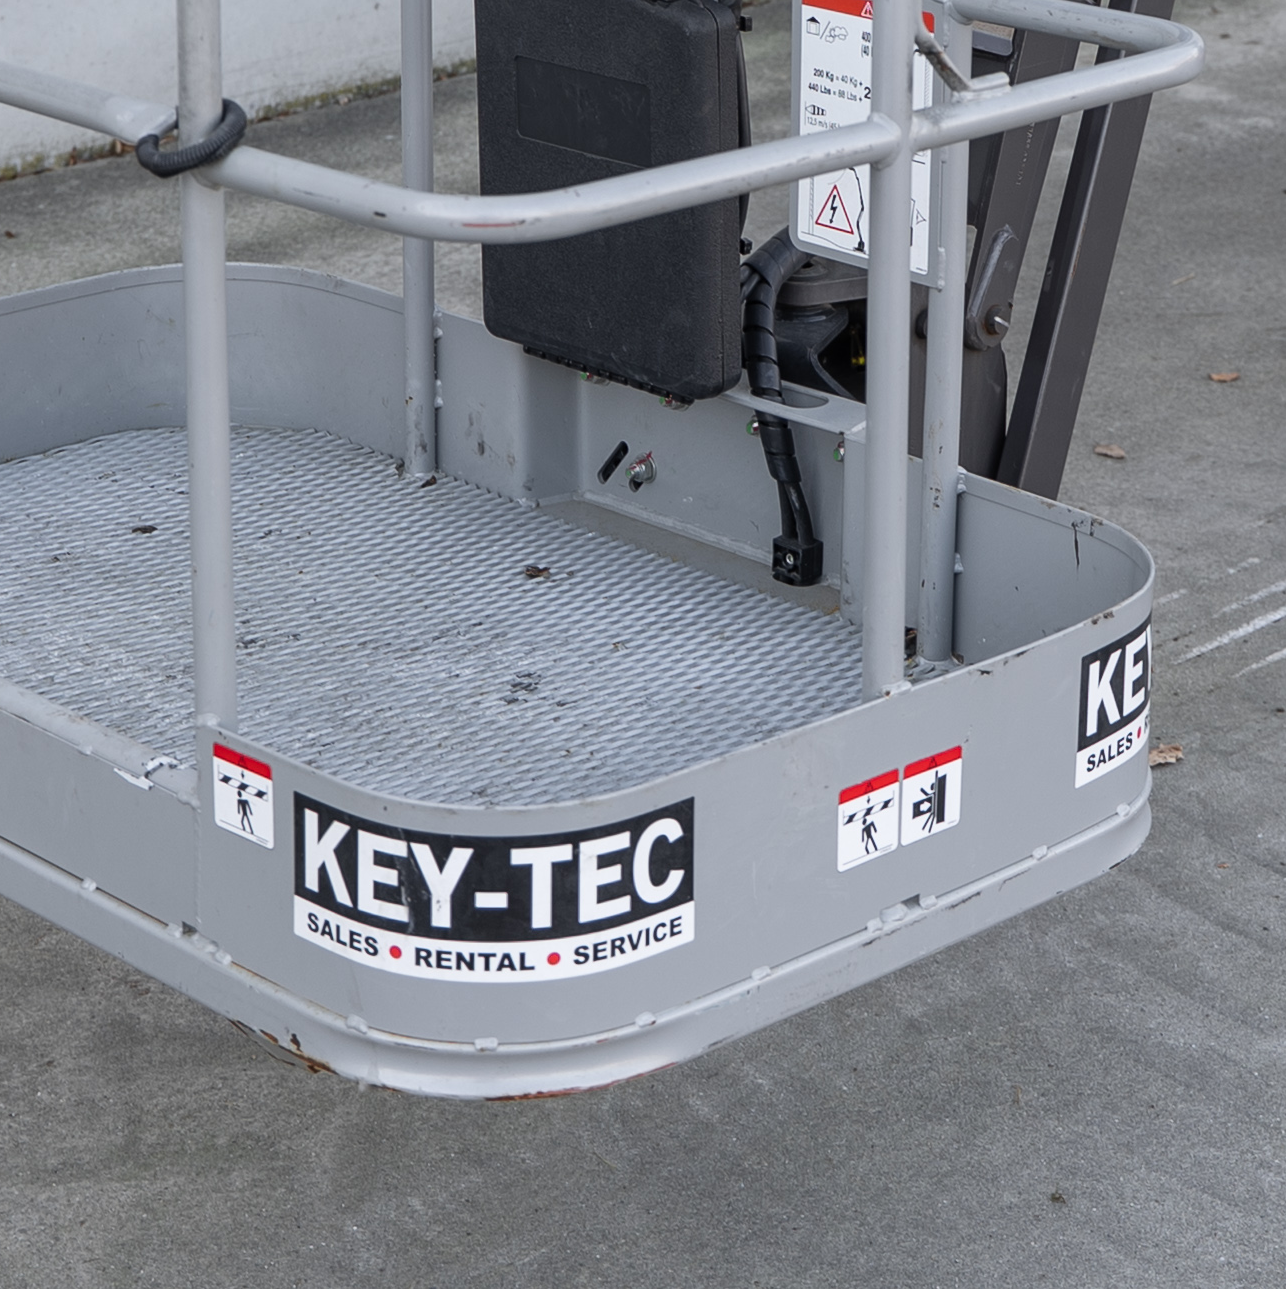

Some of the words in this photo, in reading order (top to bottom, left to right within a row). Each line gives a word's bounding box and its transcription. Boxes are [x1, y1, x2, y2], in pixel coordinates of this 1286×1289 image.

[813, 67, 824, 78] 200
[825, 70, 834, 82] Kg
[820, 84, 831, 95] Lbs
[1086, 731, 1134, 773] SALES
[304, 808, 685, 929] KEY-TEC
[307, 912, 380, 957] SALES
[414, 947, 535, 972] RENTAL
[573, 915, 683, 966] SERVICE
